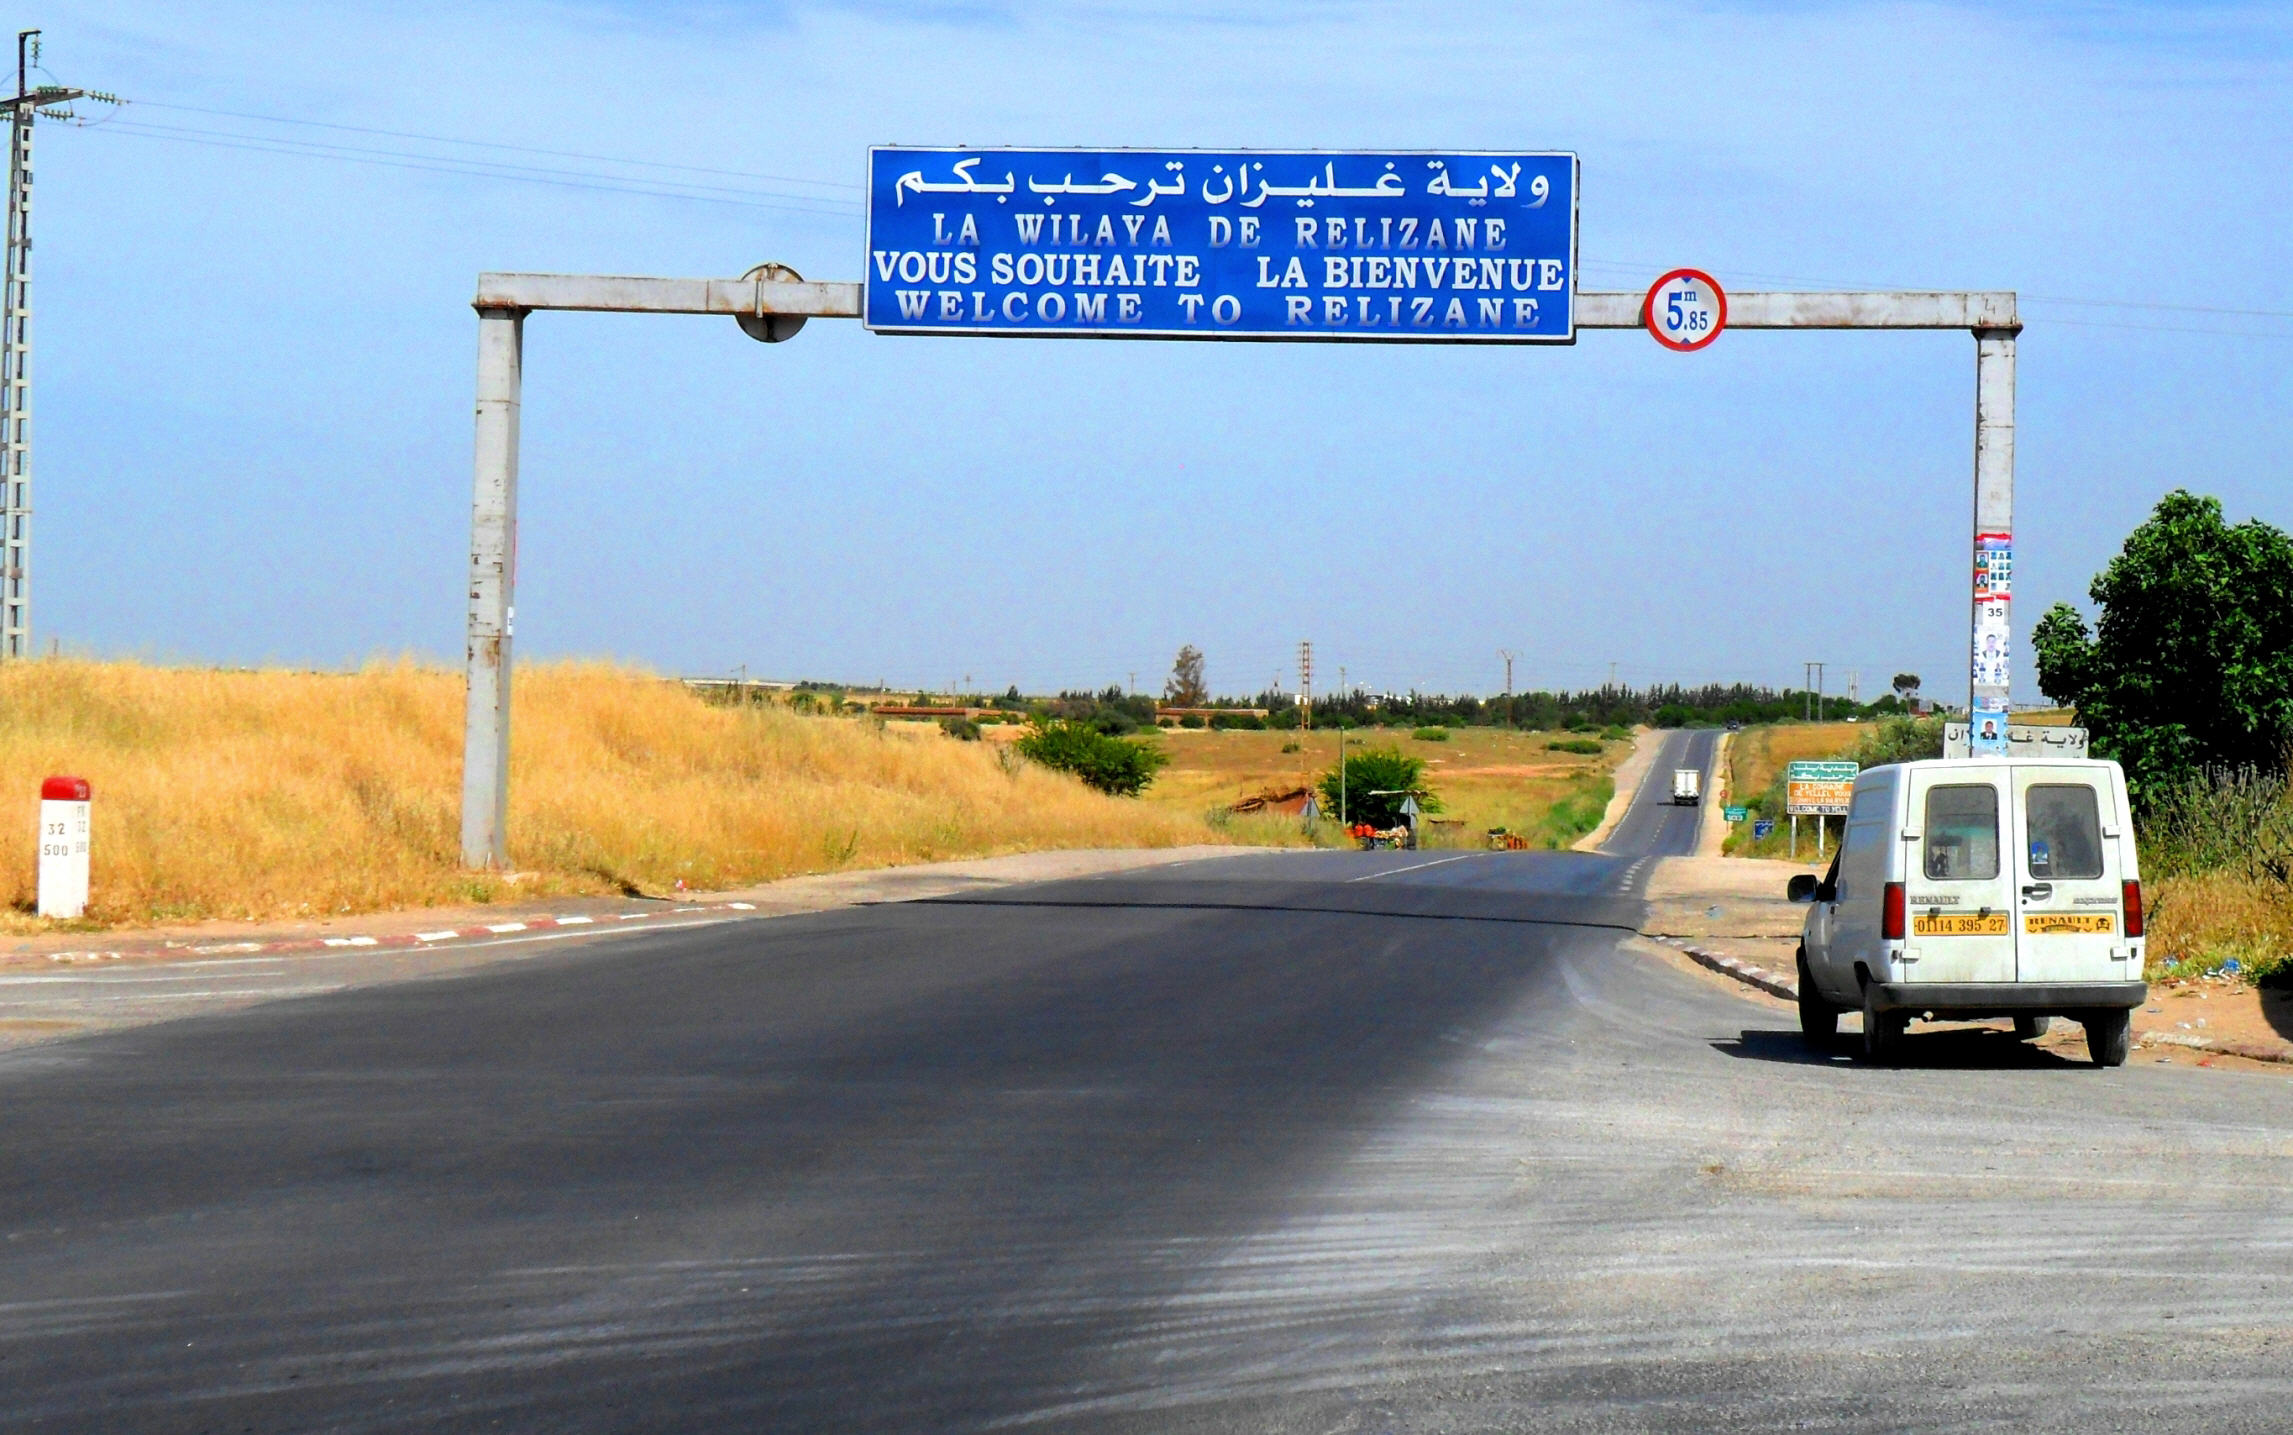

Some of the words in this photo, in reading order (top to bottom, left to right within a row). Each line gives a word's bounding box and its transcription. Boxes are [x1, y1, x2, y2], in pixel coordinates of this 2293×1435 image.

[895, 157, 1015, 208] بكم
[1028, 161, 1185, 207] ترحب
[1202, 161, 1406, 208] غليزان
[1426, 160, 1549, 209] ولاية
[933, 213, 981, 246] LA
[1015, 213, 1173, 247] WILAYA
[1208, 216, 1261, 249] DE
[1294, 217, 1507, 251] RELIZANE
[873, 250, 977, 284] VOUS
[991, 253, 1200, 287] SOUHAITE
[1256, 256, 1309, 288] LA
[1323, 256, 1564, 291] BIENVENUE
[895, 289, 1142, 324] WELCOME
[1178, 293, 1242, 324] TO
[1284, 295, 1540, 329] RELIZANE
[1987, 608, 2003, 617] 35
[48, 823, 65, 835] 32
[44, 844, 68, 856] 500
[1917, 919, 1952, 932] 01114
[1959, 919, 1981, 932] 395
[1989, 919, 2004, 932] 27
[2029, 916, 2091, 925] RENAULT
